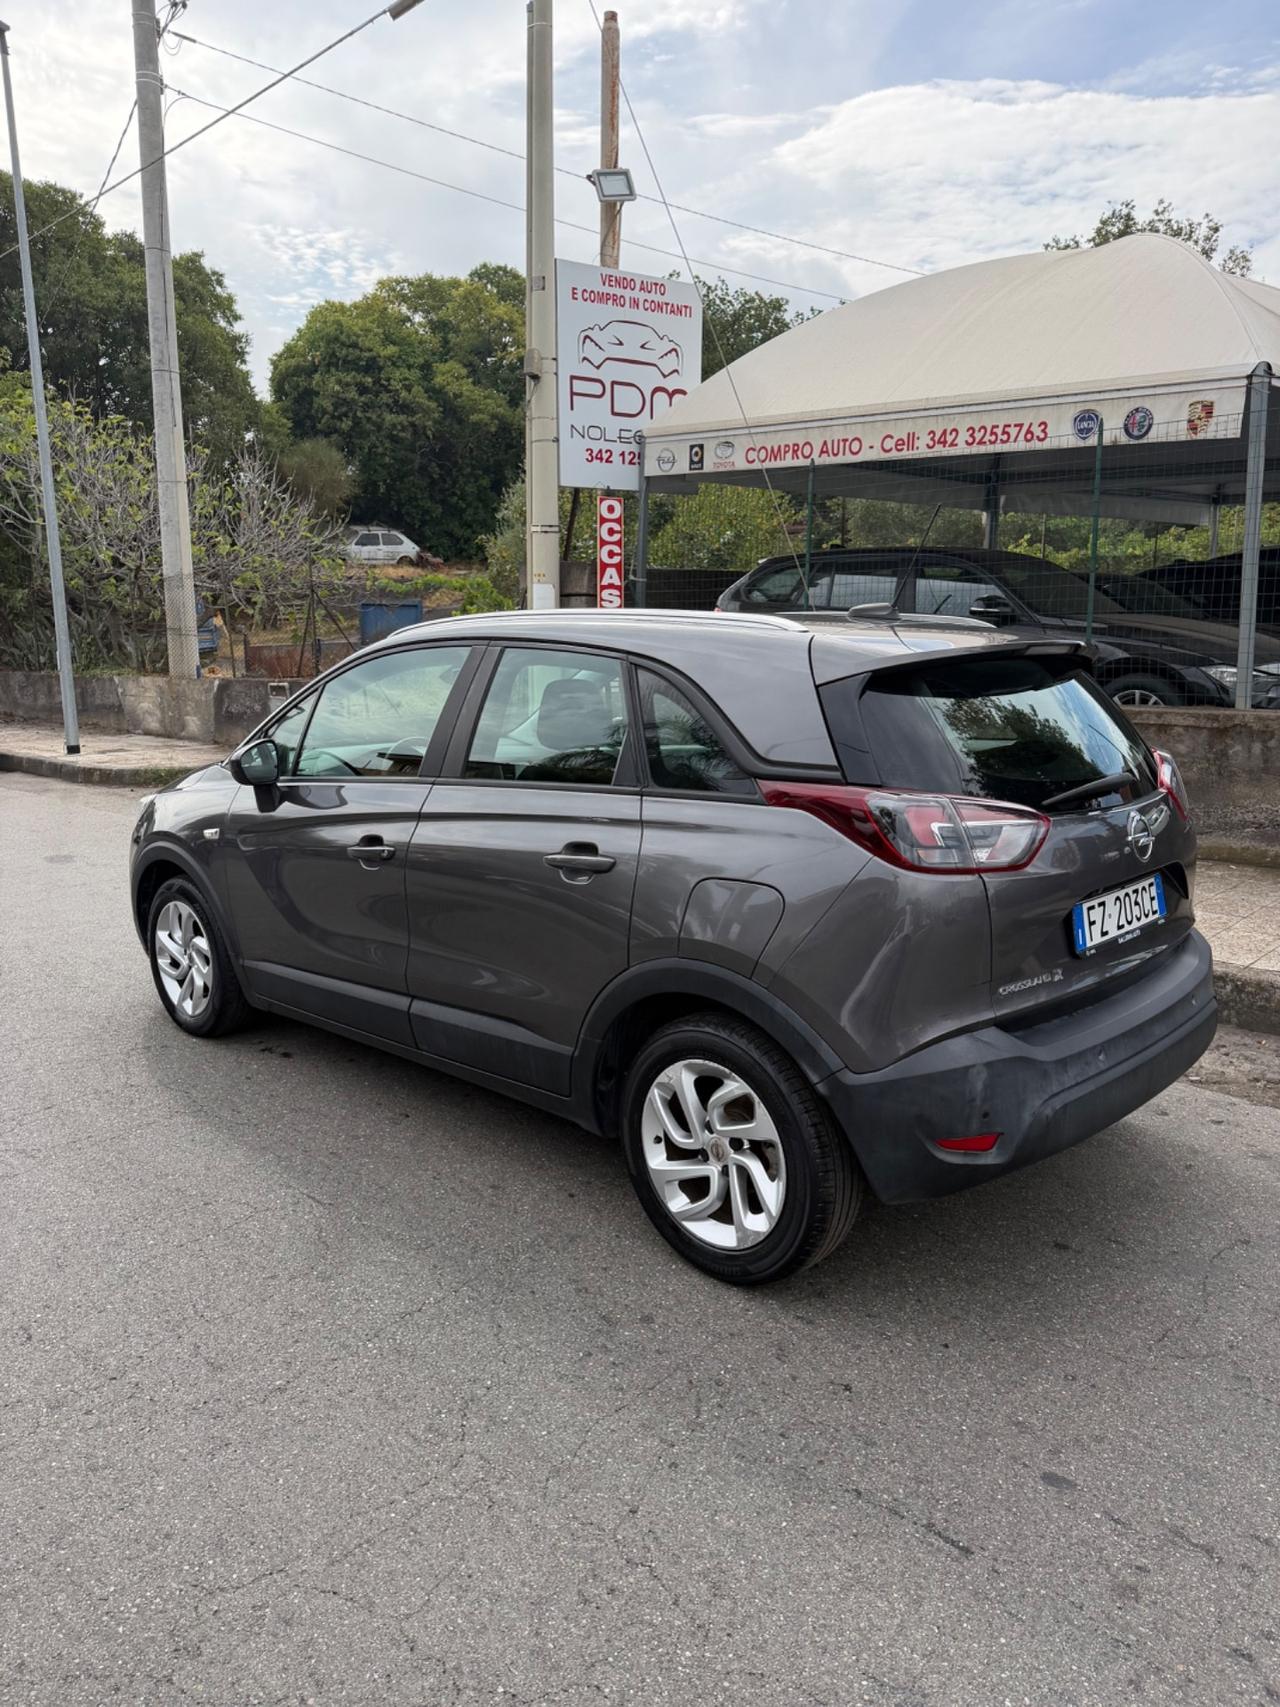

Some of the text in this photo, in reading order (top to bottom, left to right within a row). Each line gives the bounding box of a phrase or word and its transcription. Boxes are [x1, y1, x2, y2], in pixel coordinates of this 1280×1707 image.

[600, 273, 667, 296] VENDO AUTO
[571, 287, 693, 318] E COMPRO IN CONTANTI
[585, 448, 613, 464] 342
[745, 441, 814, 464] COMPRO
[818, 437, 863, 458] AUTO
[880, 431, 920, 453] Cell:
[926, 427, 960, 449] 342
[965, 421, 1049, 447] 3255763
[1086, 882, 1158, 942] FZ 203CE
